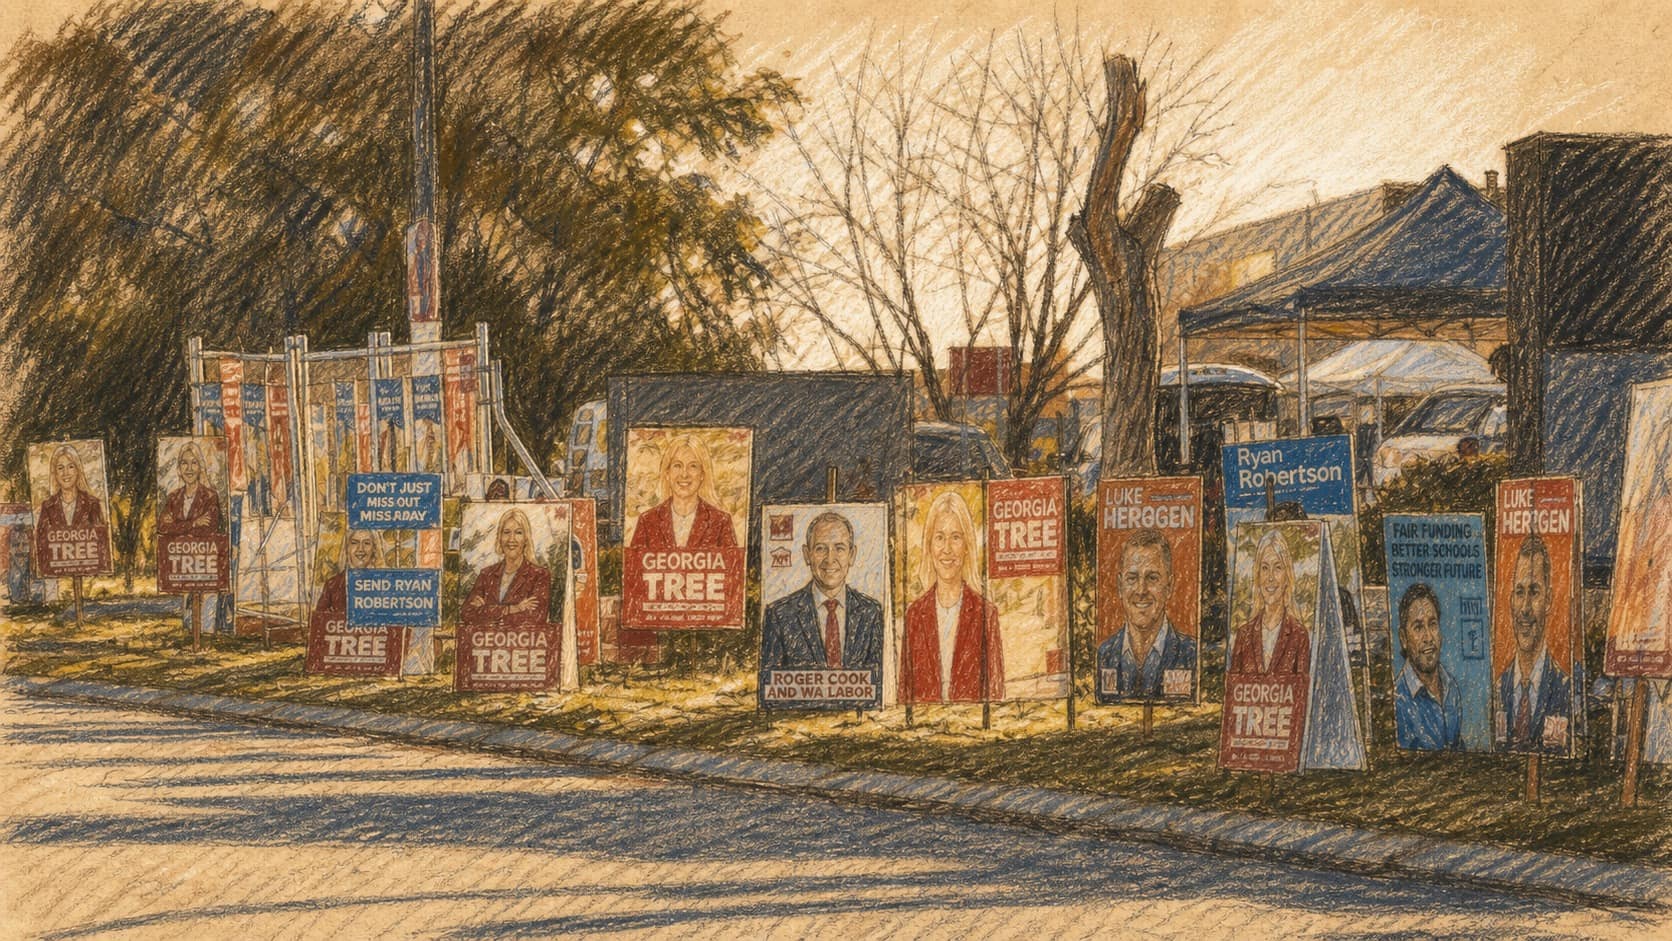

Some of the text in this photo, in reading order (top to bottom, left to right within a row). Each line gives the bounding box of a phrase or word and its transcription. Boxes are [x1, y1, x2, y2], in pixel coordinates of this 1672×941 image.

[1237, 447, 1283, 470] Ryan
[1238, 465, 1342, 489] Robertson
[357, 481, 433, 494] DON'T JUST
[1105, 486, 1144, 505] LUKE
[366, 496, 421, 508] MISS OUT
[1503, 488, 1535, 508] LUKE
[360, 510, 391, 522] MISS
[992, 498, 1058, 520] GEORGIA
[47, 530, 98, 543] GEORGIA
[993, 519, 1058, 550] TREE
[1392, 522, 1472, 539] FAIR FUNDING
[49, 543, 99, 560] TREE
[167, 541, 219, 555] GEORGIA
[1392, 543, 1480, 559] BETTER SCHOOLS
[168, 555, 219, 574] TREE
[642, 552, 726, 570] GEORGIA
[1392, 561, 1483, 579] STRONGER FUTURE
[354, 579, 432, 592] SEND RYAN
[642, 572, 725, 601] TREE
[353, 596, 434, 609] ROBERTSON
[324, 634, 388, 656] TREE
[471, 631, 548, 647] GEORGIA
[471, 649, 547, 673] TREE
[773, 672, 871, 686] ROGER COOK
[767, 686, 873, 698] AND WA LABOR
[1233, 683, 1295, 703] GEORGIA
[1231, 705, 1294, 738] TREE
